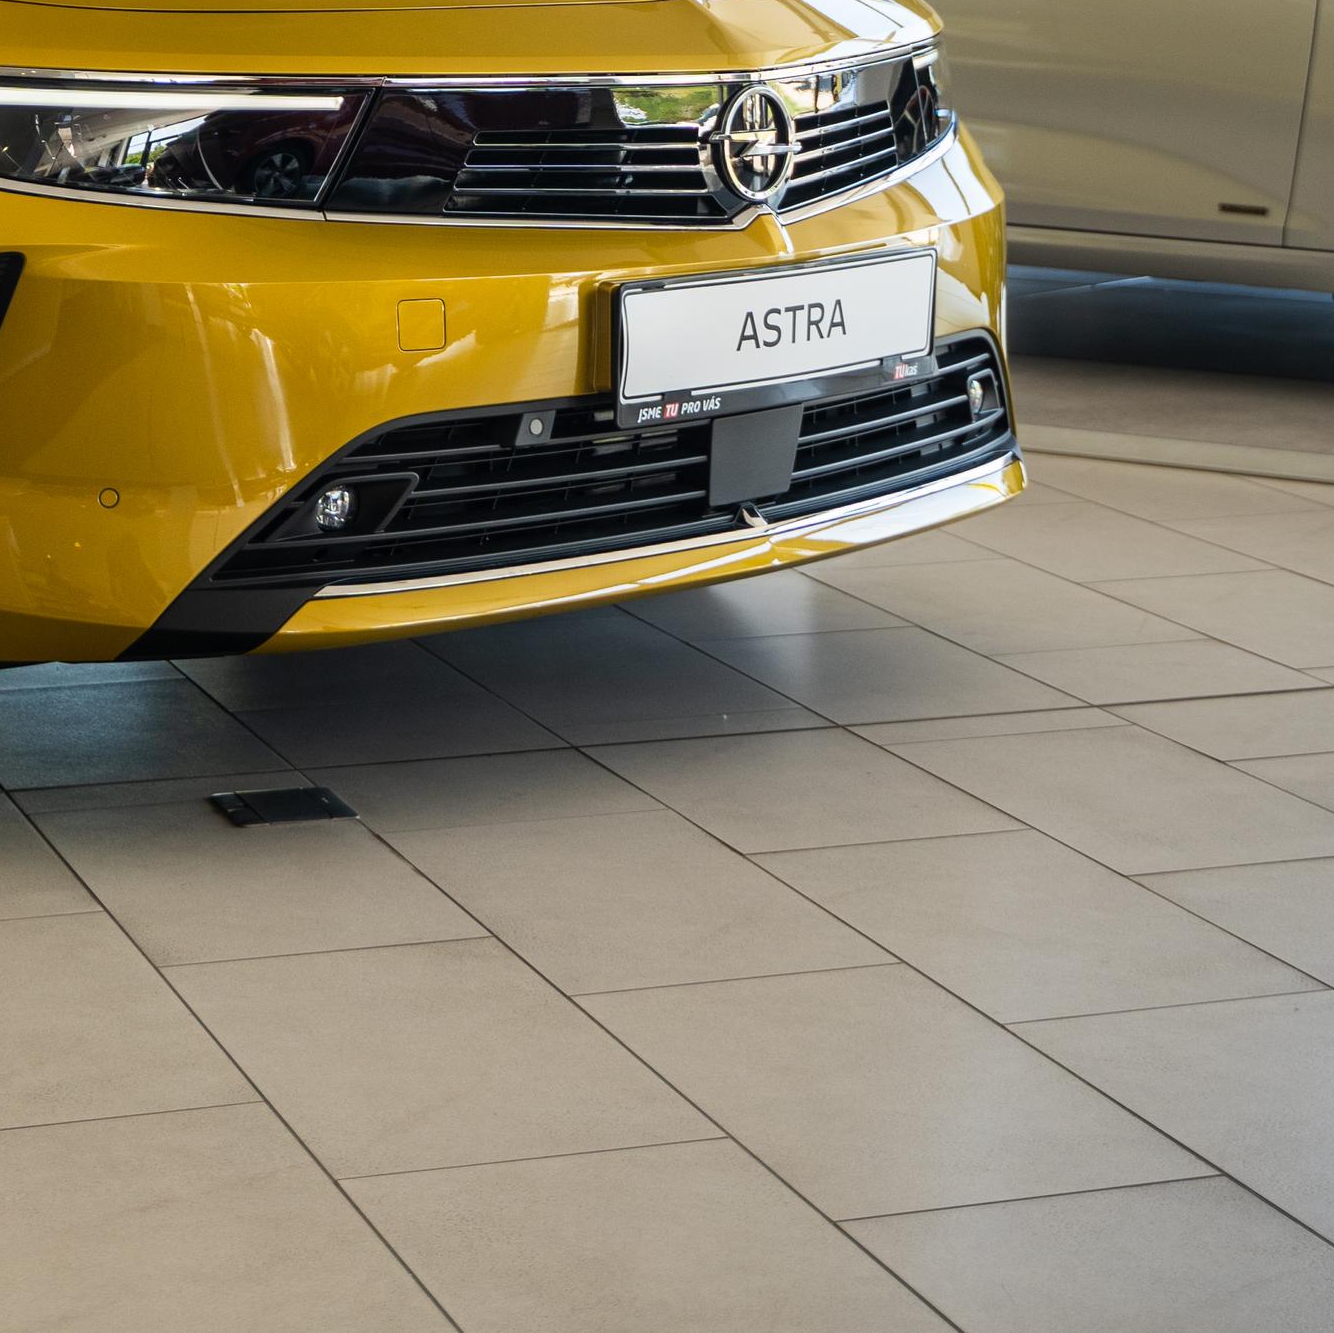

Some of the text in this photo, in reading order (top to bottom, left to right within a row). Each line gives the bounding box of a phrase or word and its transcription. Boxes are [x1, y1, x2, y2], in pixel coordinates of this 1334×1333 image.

[736, 298, 847, 351] ASTRA
[637, 395, 722, 423] JSME TU PRO VÁS
